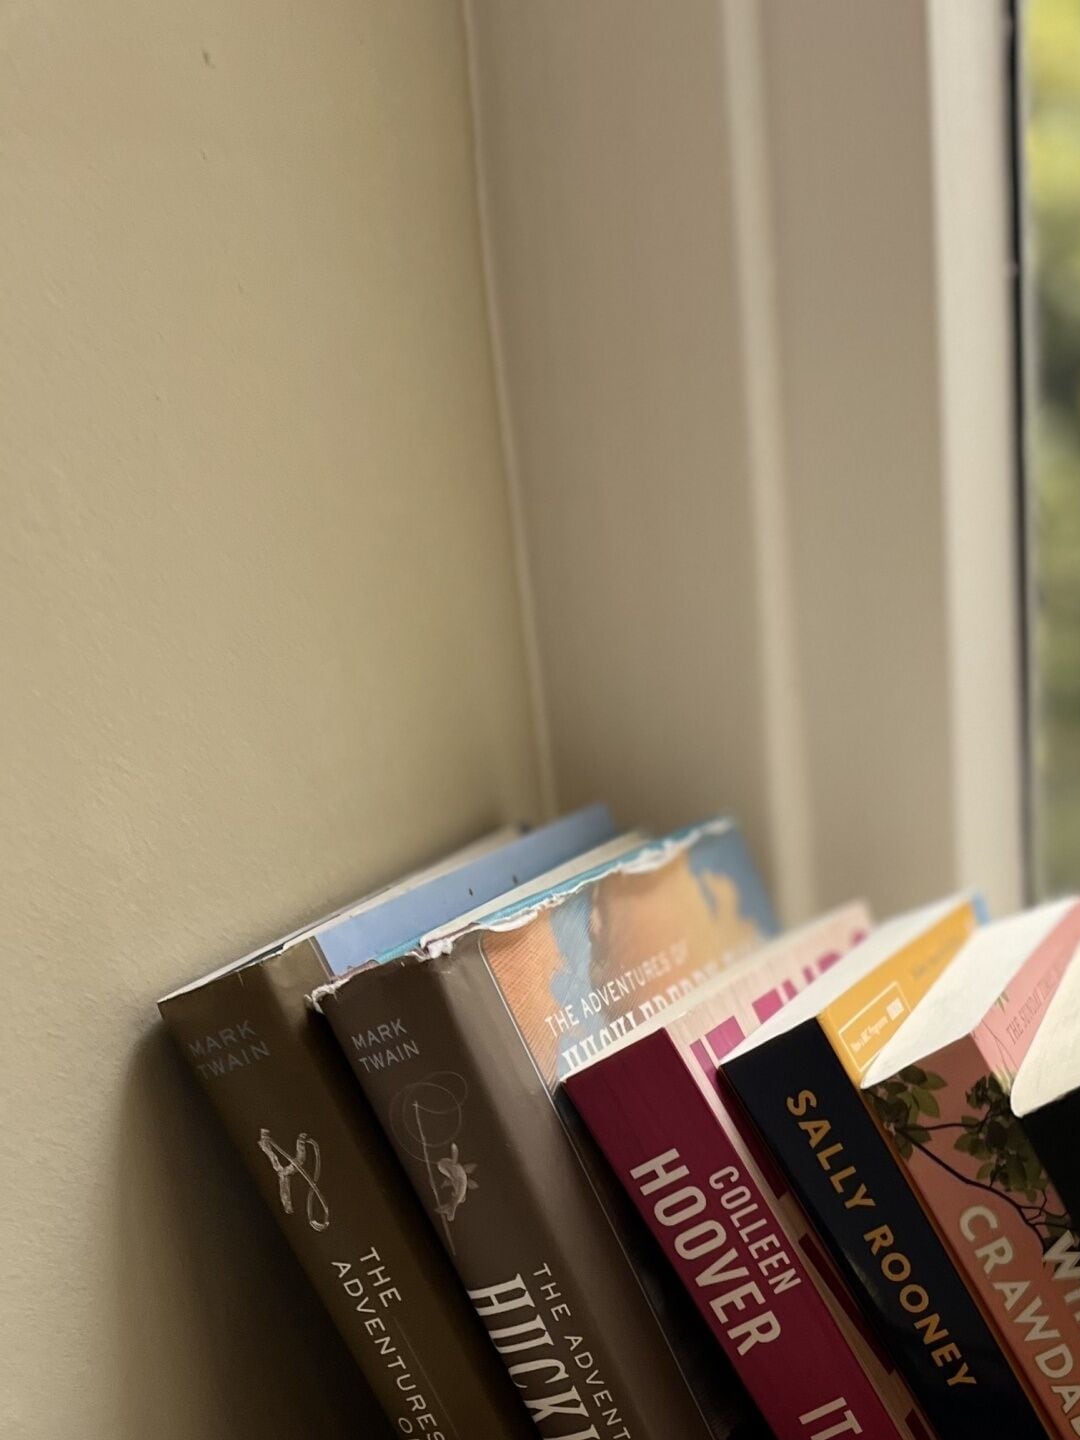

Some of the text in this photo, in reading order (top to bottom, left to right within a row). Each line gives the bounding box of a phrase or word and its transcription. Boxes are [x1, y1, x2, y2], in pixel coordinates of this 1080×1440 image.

[188, 1020, 257, 1058] MARK
[351, 1018, 408, 1051] MARK
[544, 1004, 581, 1039] THE
[197, 1041, 272, 1080] TWAIN
[358, 1040, 421, 1073] TWAIN
[629, 1147, 782, 1357] HOOVER
[708, 1165, 802, 1295] COLLEEN
[786, 1089, 978, 1388] SALLY ROONEY
[359, 1246, 402, 1308] THE
[533, 1262, 572, 1322] THE
